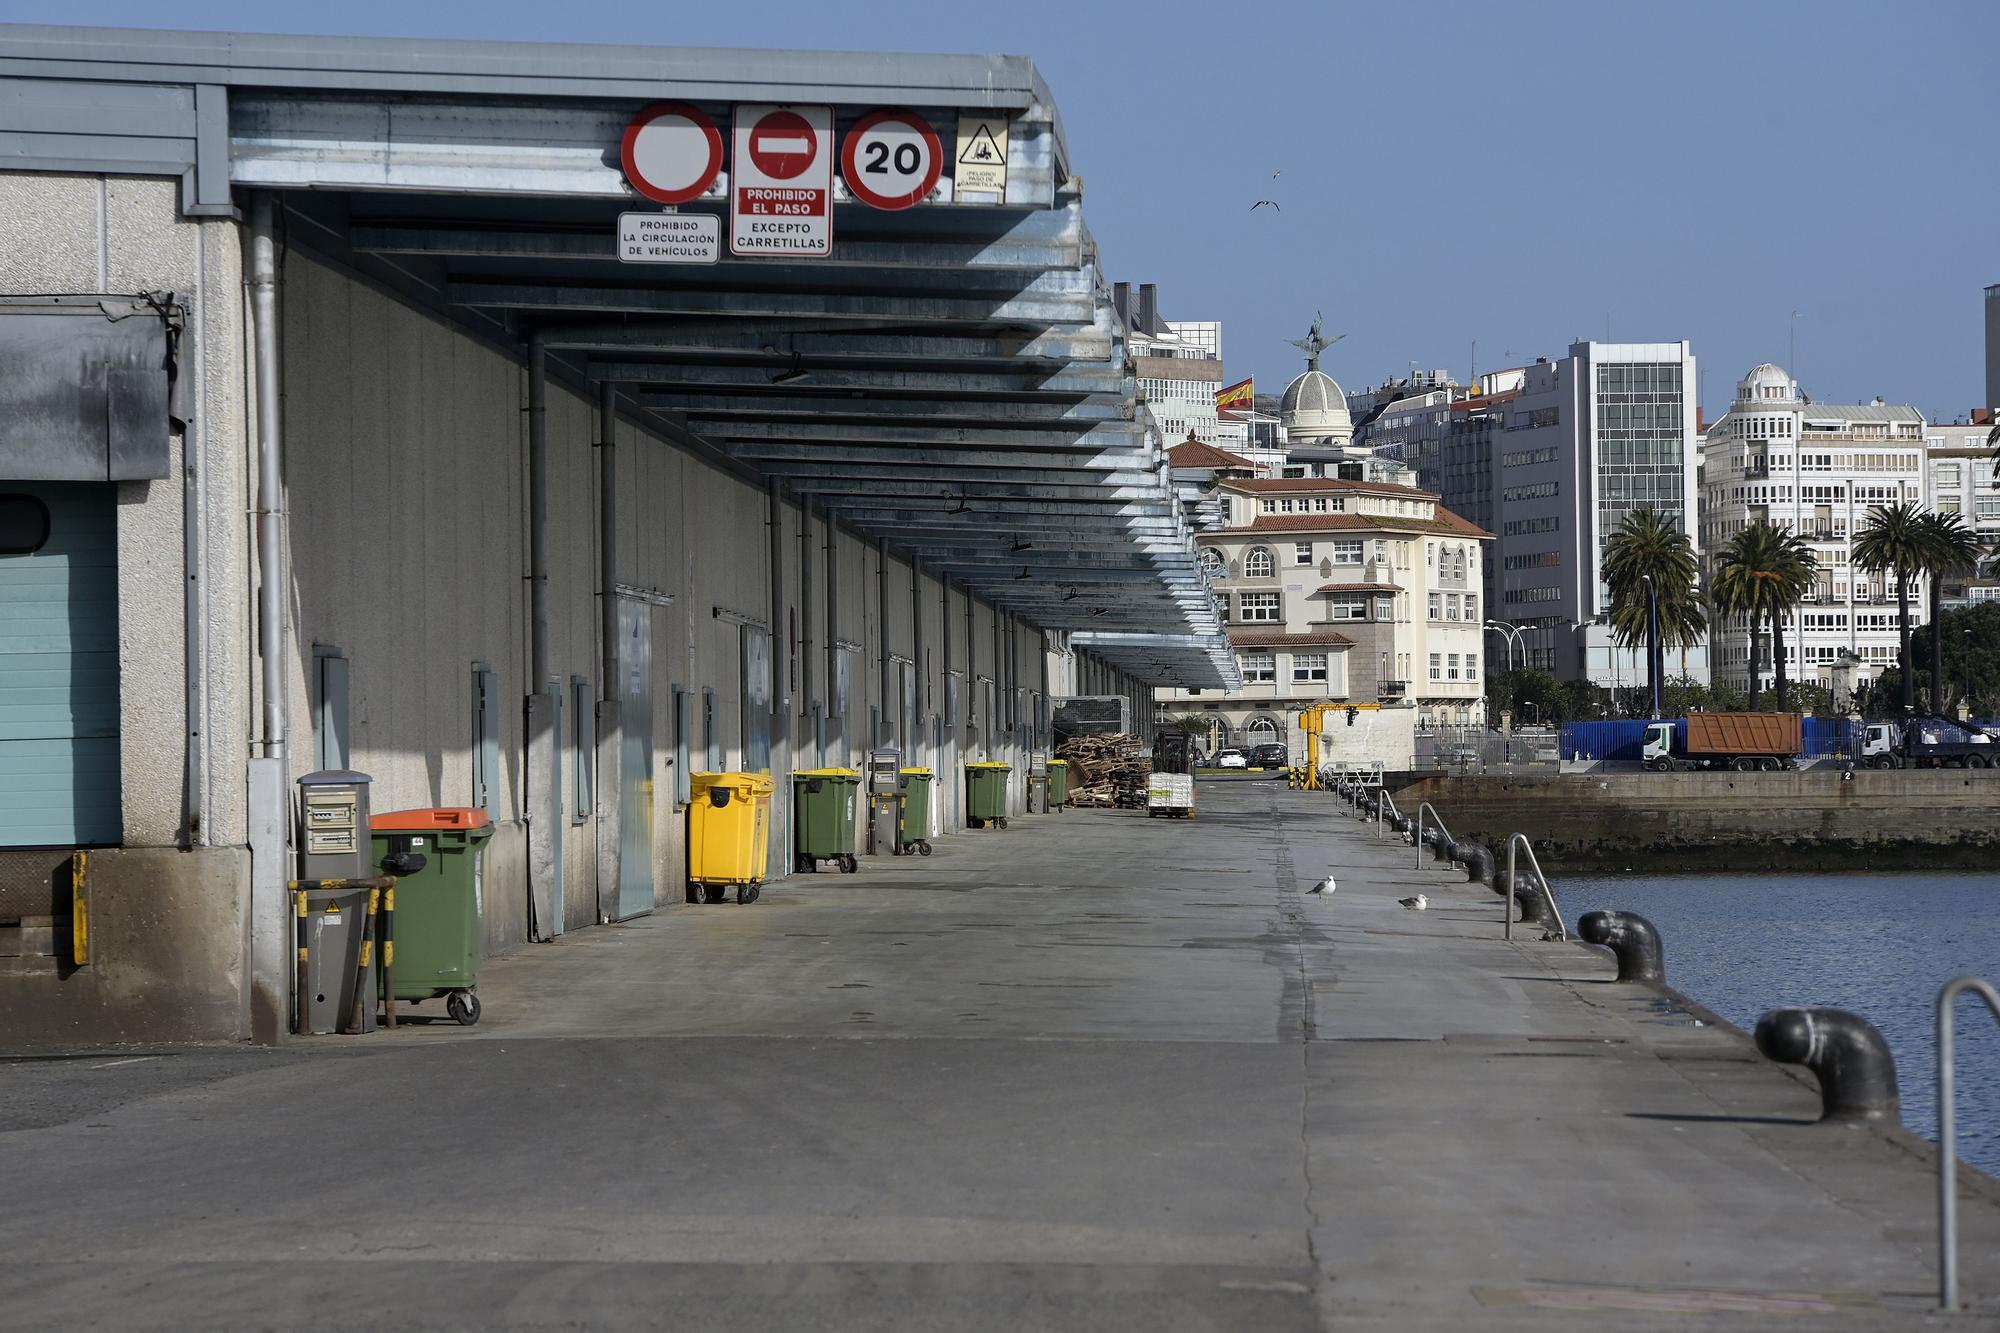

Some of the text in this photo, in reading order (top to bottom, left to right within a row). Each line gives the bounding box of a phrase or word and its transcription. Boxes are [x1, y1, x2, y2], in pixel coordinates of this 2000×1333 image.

[865, 141, 921, 175] 20
[747, 189, 817, 201] PROHIBIDO
[752, 203, 811, 214] EL PASO
[640, 221, 698, 231] PROHIBIDO
[752, 222, 811, 233] EXCEPTO
[623, 233, 715, 244] LA CIRCULACIÓN
[737, 237, 825, 249] CARRETILLAS
[629, 246, 708, 256] DE VEHÍCULOS
[1845, 772, 1851, 780] 2
